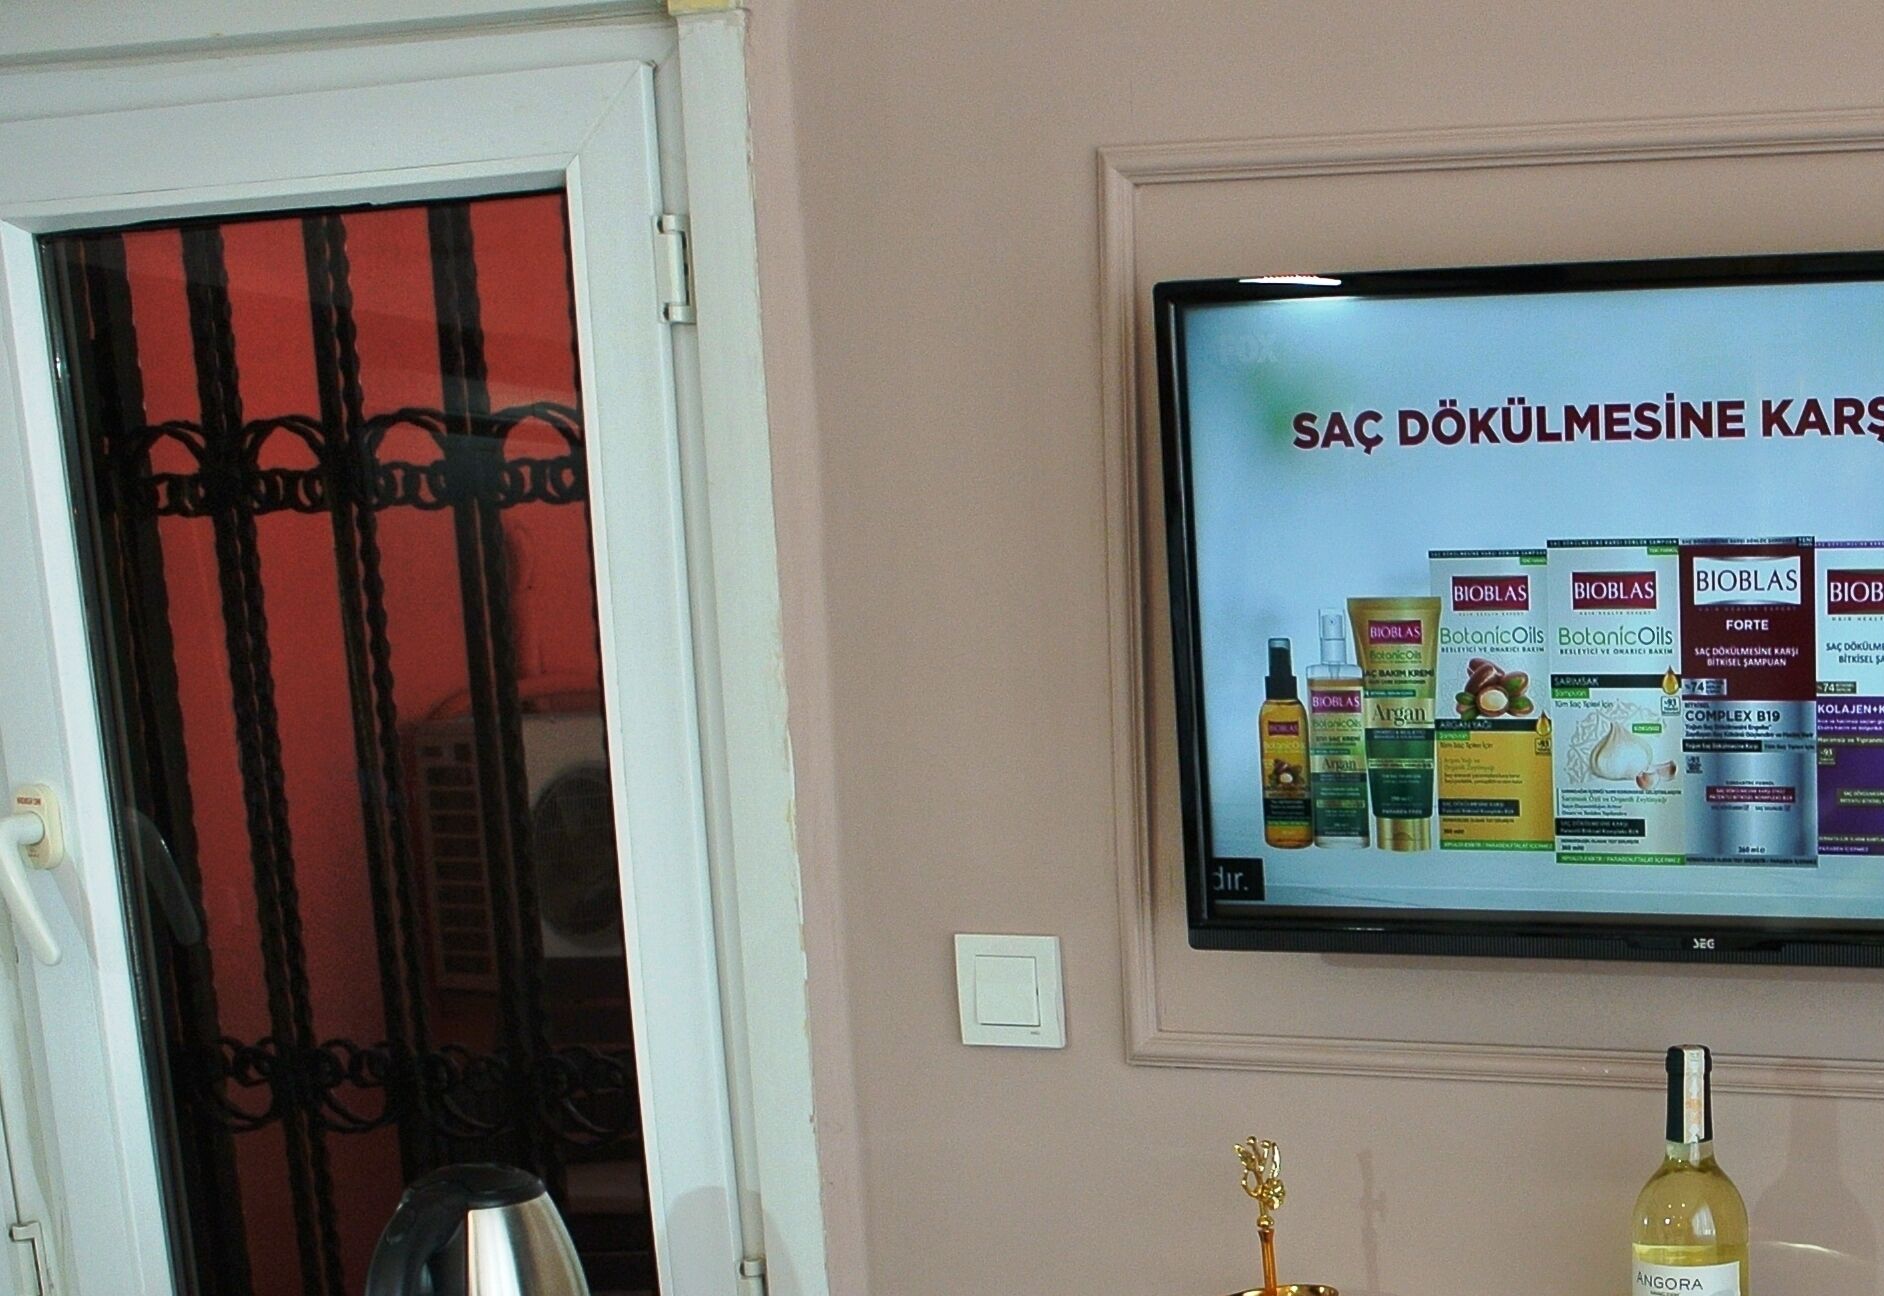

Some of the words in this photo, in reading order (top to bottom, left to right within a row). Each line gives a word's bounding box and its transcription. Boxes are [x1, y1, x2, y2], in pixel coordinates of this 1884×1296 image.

[1292, 409, 1384, 455] SAÇ
[1397, 392, 1747, 446] DÖKÜLMESİNE
[1696, 569, 1798, 592] BIOBLAS
[1454, 585, 1527, 602] BIOBLAS
[1574, 581, 1654, 599] BIOBLAS
[1726, 619, 1769, 630] FORTE
[1370, 627, 1421, 639] BIOBLAS
[1440, 625, 1545, 645] BotanicOils
[1558, 625, 1673, 645] BotanicOils
[1694, 648, 1710, 657] SAÇ
[1712, 646, 1772, 656] DÖKÜLMESİNE
[1774, 648, 1799, 657] KARŞI
[1826, 643, 1842, 652] SAÇ
[1707, 657, 1741, 667] BİTKİSEL
[1743, 658, 1787, 668] ŞAMPUAN
[1838, 655, 1873, 664] BİTKİSEL
[1312, 696, 1360, 708] BIOBLAS
[1373, 703, 1426, 727] Argan
[1685, 710, 1752, 722] COMPLEX
[1757, 710, 1780, 722] B19
[199, 862, 280, 896] VESTEL
[1692, 938, 1715, 950] SEG
[1636, 1271, 1704, 1291] ANGORA
